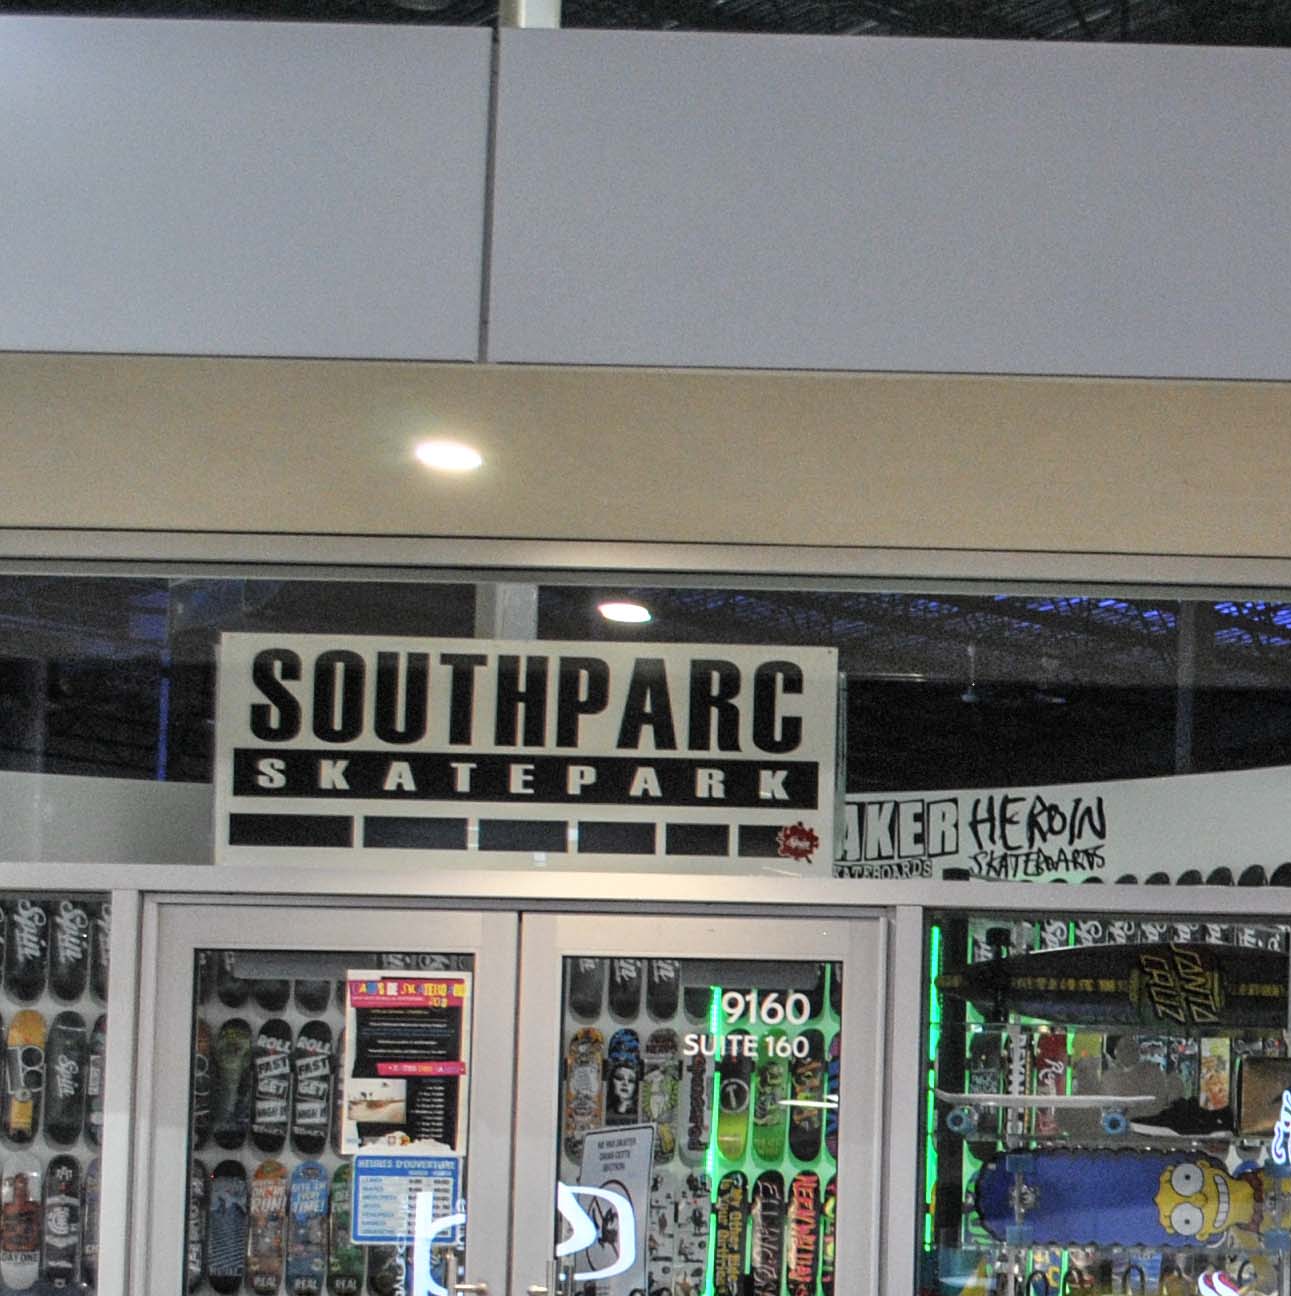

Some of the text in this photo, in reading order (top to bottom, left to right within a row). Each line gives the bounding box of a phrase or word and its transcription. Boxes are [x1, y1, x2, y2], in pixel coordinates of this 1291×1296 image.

[250, 648, 804, 754] SOUTHPARC
[257, 758, 789, 800] SKATEPARK
[968, 794, 1107, 852] HEROIN
[721, 991, 811, 1025] 9160
[683, 1034, 810, 1058] SUITE 160
